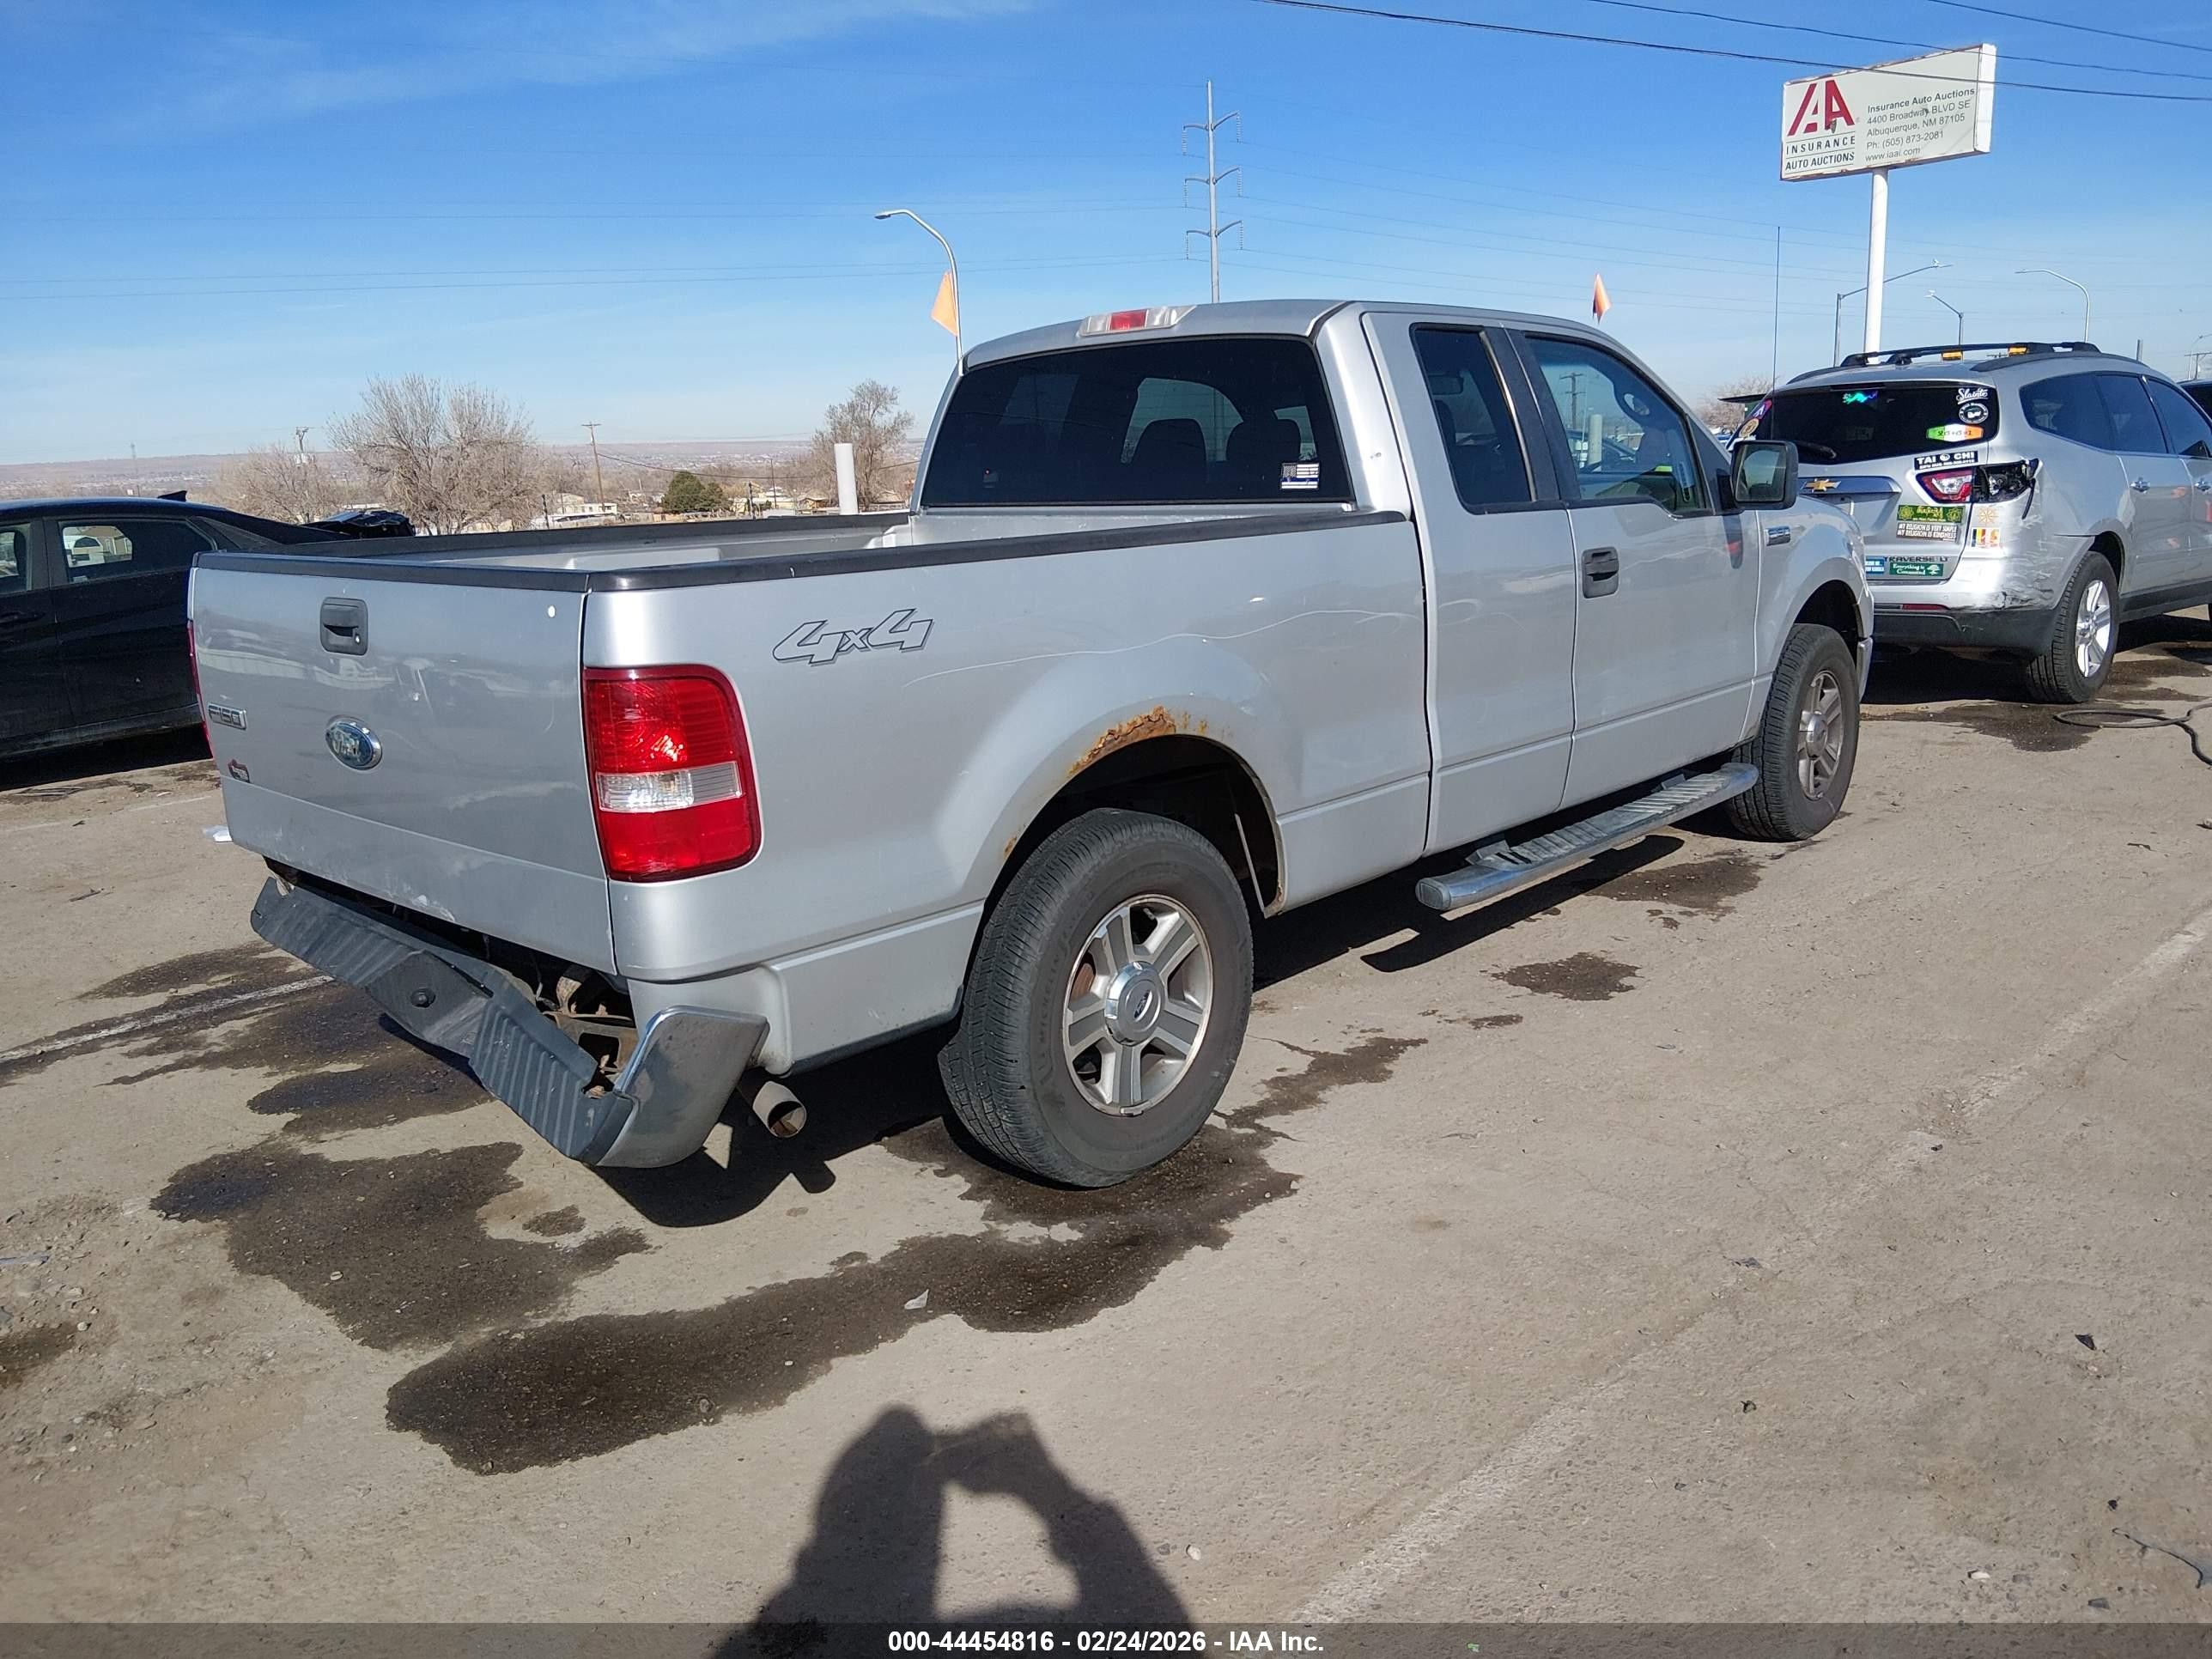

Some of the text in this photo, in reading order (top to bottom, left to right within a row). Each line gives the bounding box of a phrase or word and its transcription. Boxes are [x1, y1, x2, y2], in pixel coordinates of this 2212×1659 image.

[1868, 88, 1975, 113] Insurance Auto Auctions
[1867, 100, 1971, 125] 4400 Broadway BLVD SE
[1867, 112, 1966, 137] Albuquerque, NM 87105
[1786, 135, 1855, 155] INSURANCE
[1866, 130, 1944, 150] Ph: (505) 873-2081
[1785, 151, 1855, 171] AUTO AUCTIONS
[1917, 455, 1936, 465] TAI
[1954, 451, 1975, 460] CHI
[773, 608, 934, 665] 4x4
